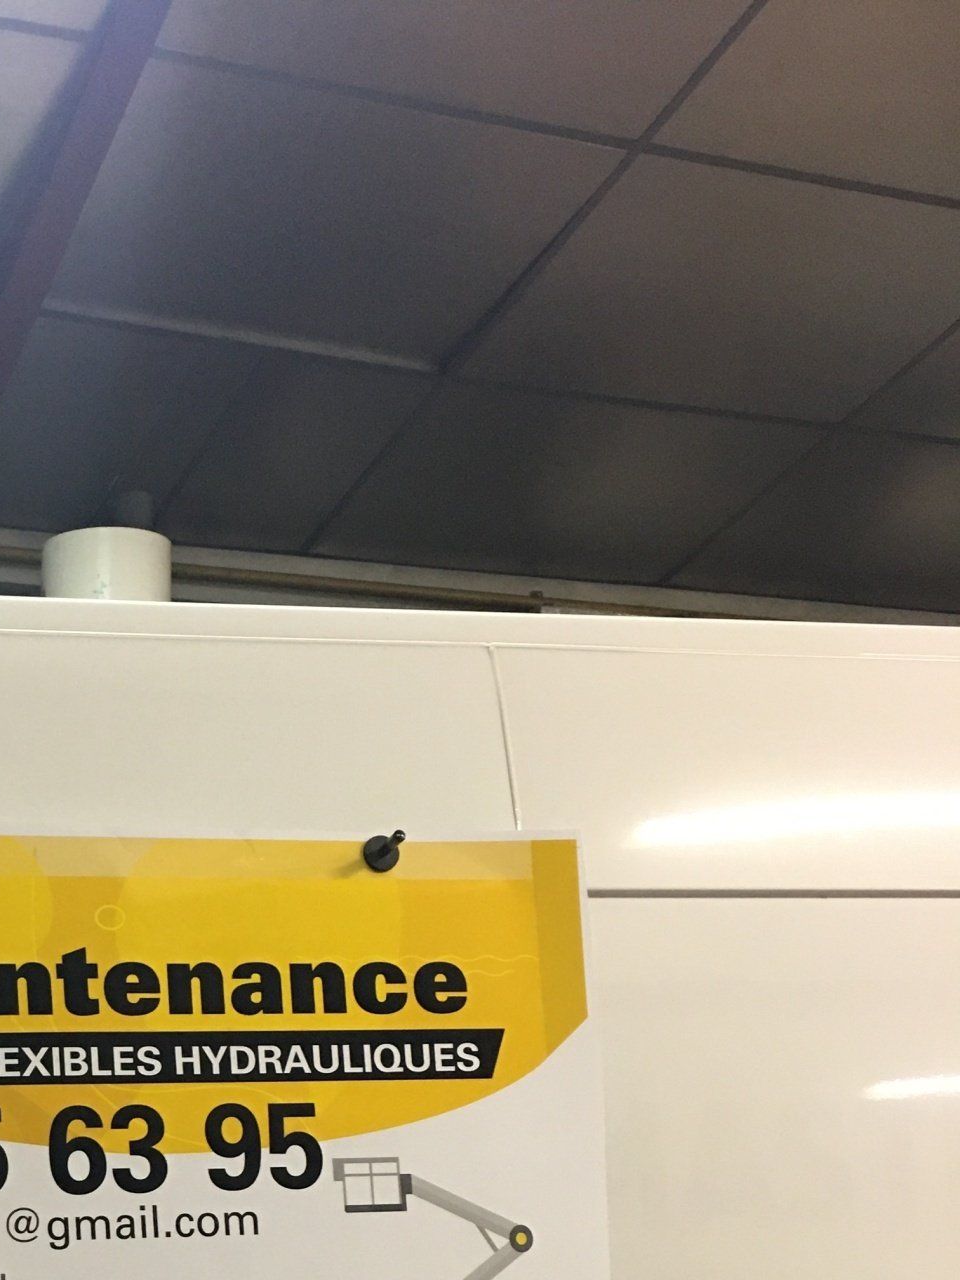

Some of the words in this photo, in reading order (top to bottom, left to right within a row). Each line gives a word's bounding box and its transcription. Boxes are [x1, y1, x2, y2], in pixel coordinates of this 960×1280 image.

[174, 1042, 481, 1077] HYDRAULIQUES
[47, 1103, 168, 1194] 63
[203, 1101, 324, 1191] 95
